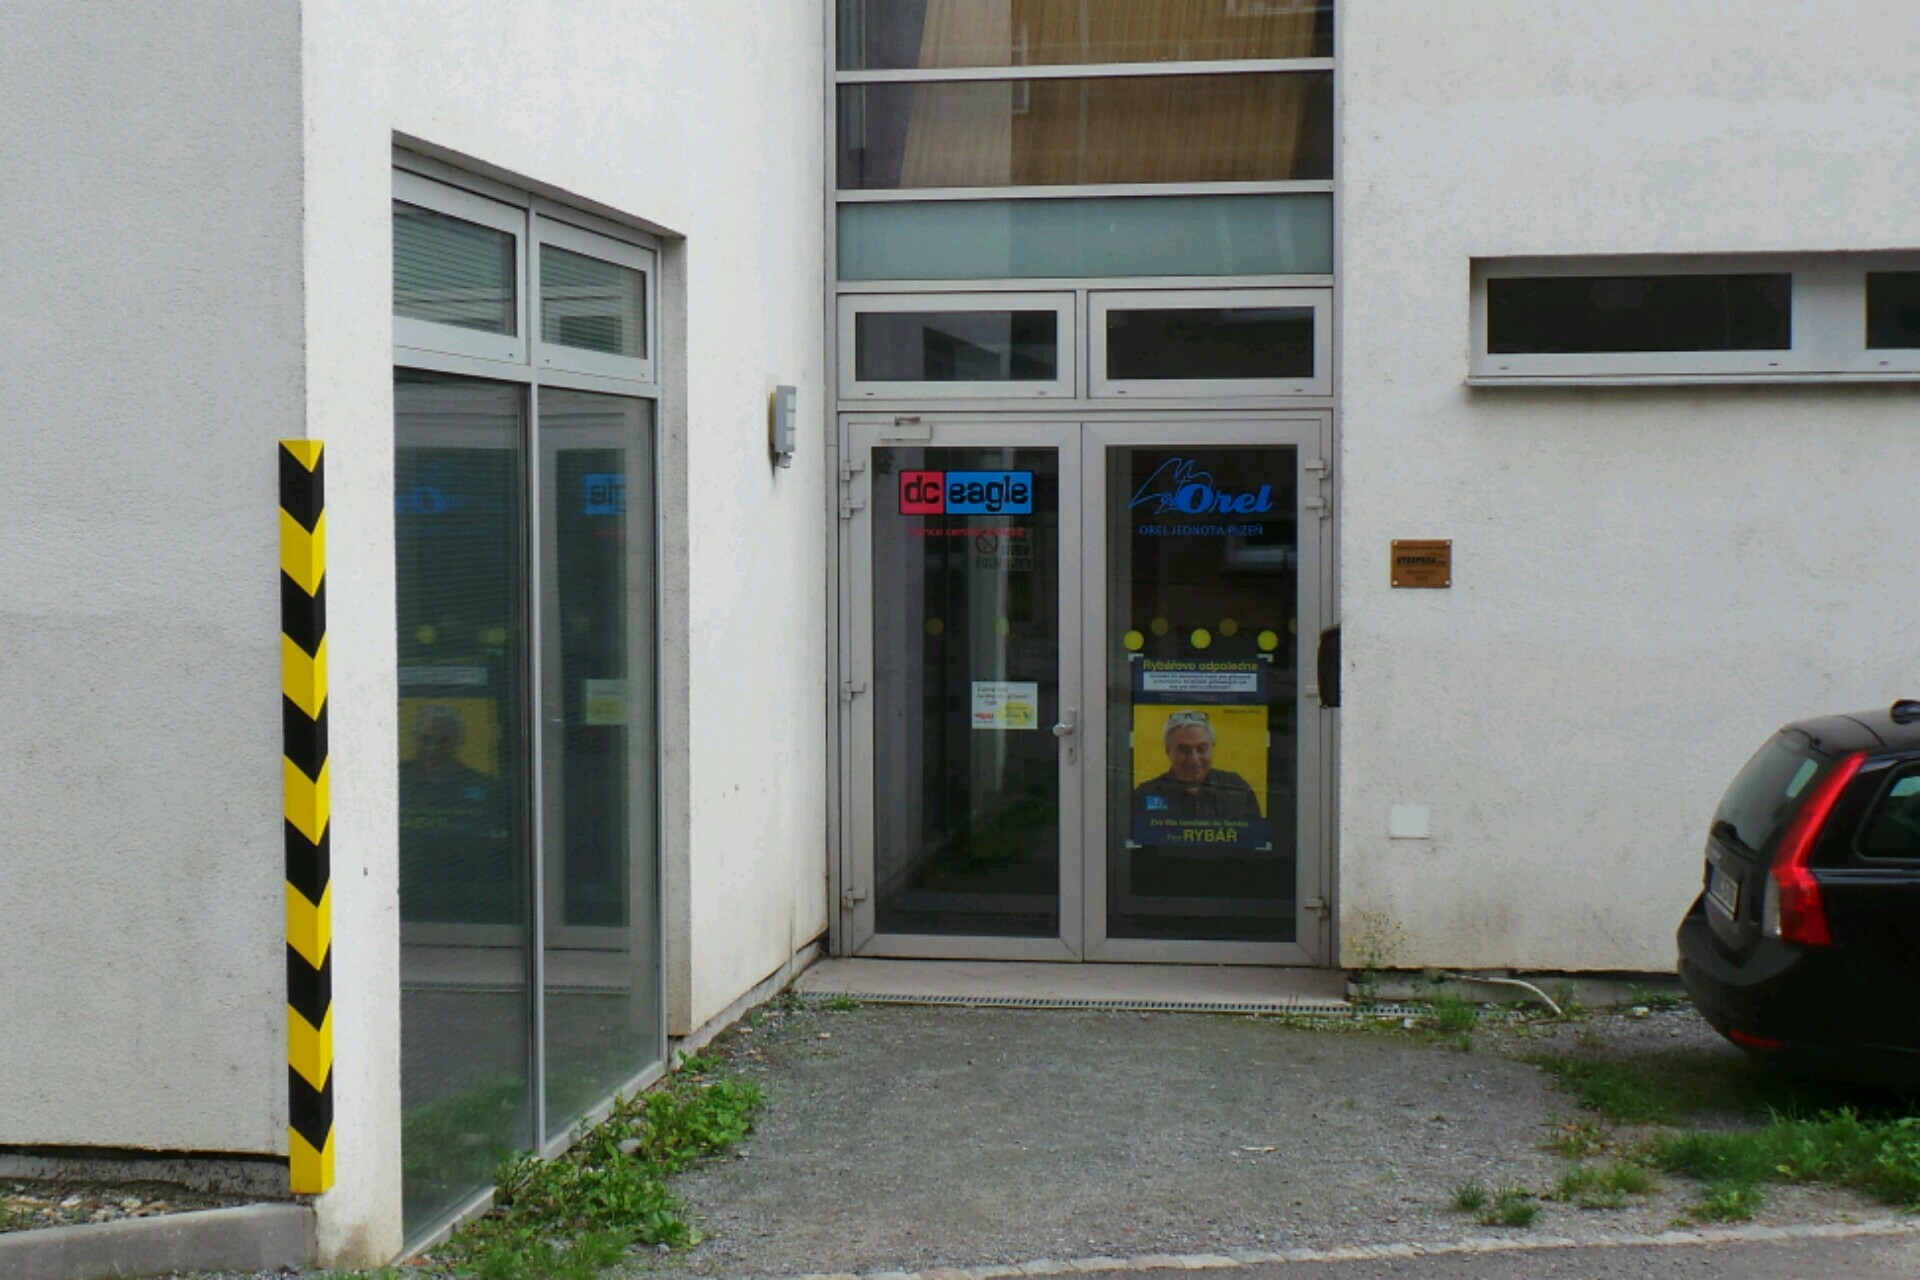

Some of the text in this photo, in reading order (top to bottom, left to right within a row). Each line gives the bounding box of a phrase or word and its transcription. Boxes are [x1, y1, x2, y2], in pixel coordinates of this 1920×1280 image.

[904, 475, 1029, 512] dc eagle
[1175, 482, 1273, 515] Orel
[1138, 525, 1167, 536] OREL
[1171, 525, 1224, 536] JEDNOTA
[1183, 828, 1238, 842] RYBÁŘ
